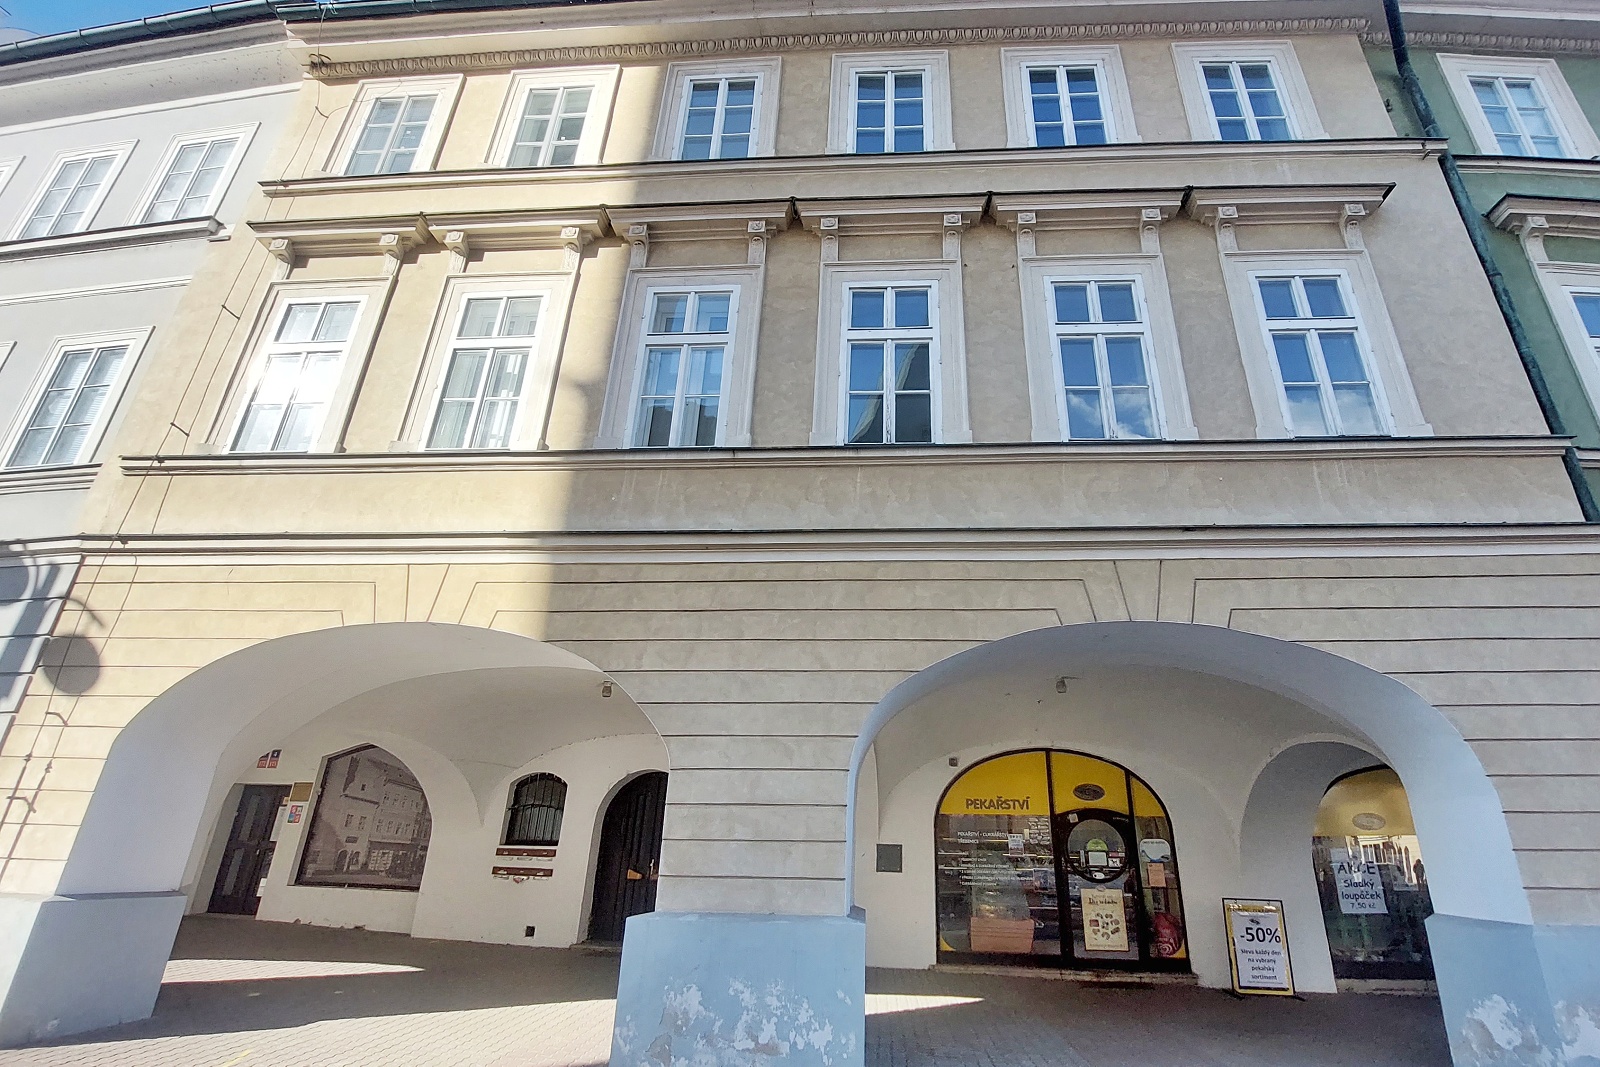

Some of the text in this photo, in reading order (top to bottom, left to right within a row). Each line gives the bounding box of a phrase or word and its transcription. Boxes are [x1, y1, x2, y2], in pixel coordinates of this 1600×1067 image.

[965, 795, 1030, 809] PEKAŘSTVÍ
[1343, 879, 1374, 889] Sladký
[1341, 891, 1381, 902] loupáček
[1240, 926, 1281, 943] -50%
